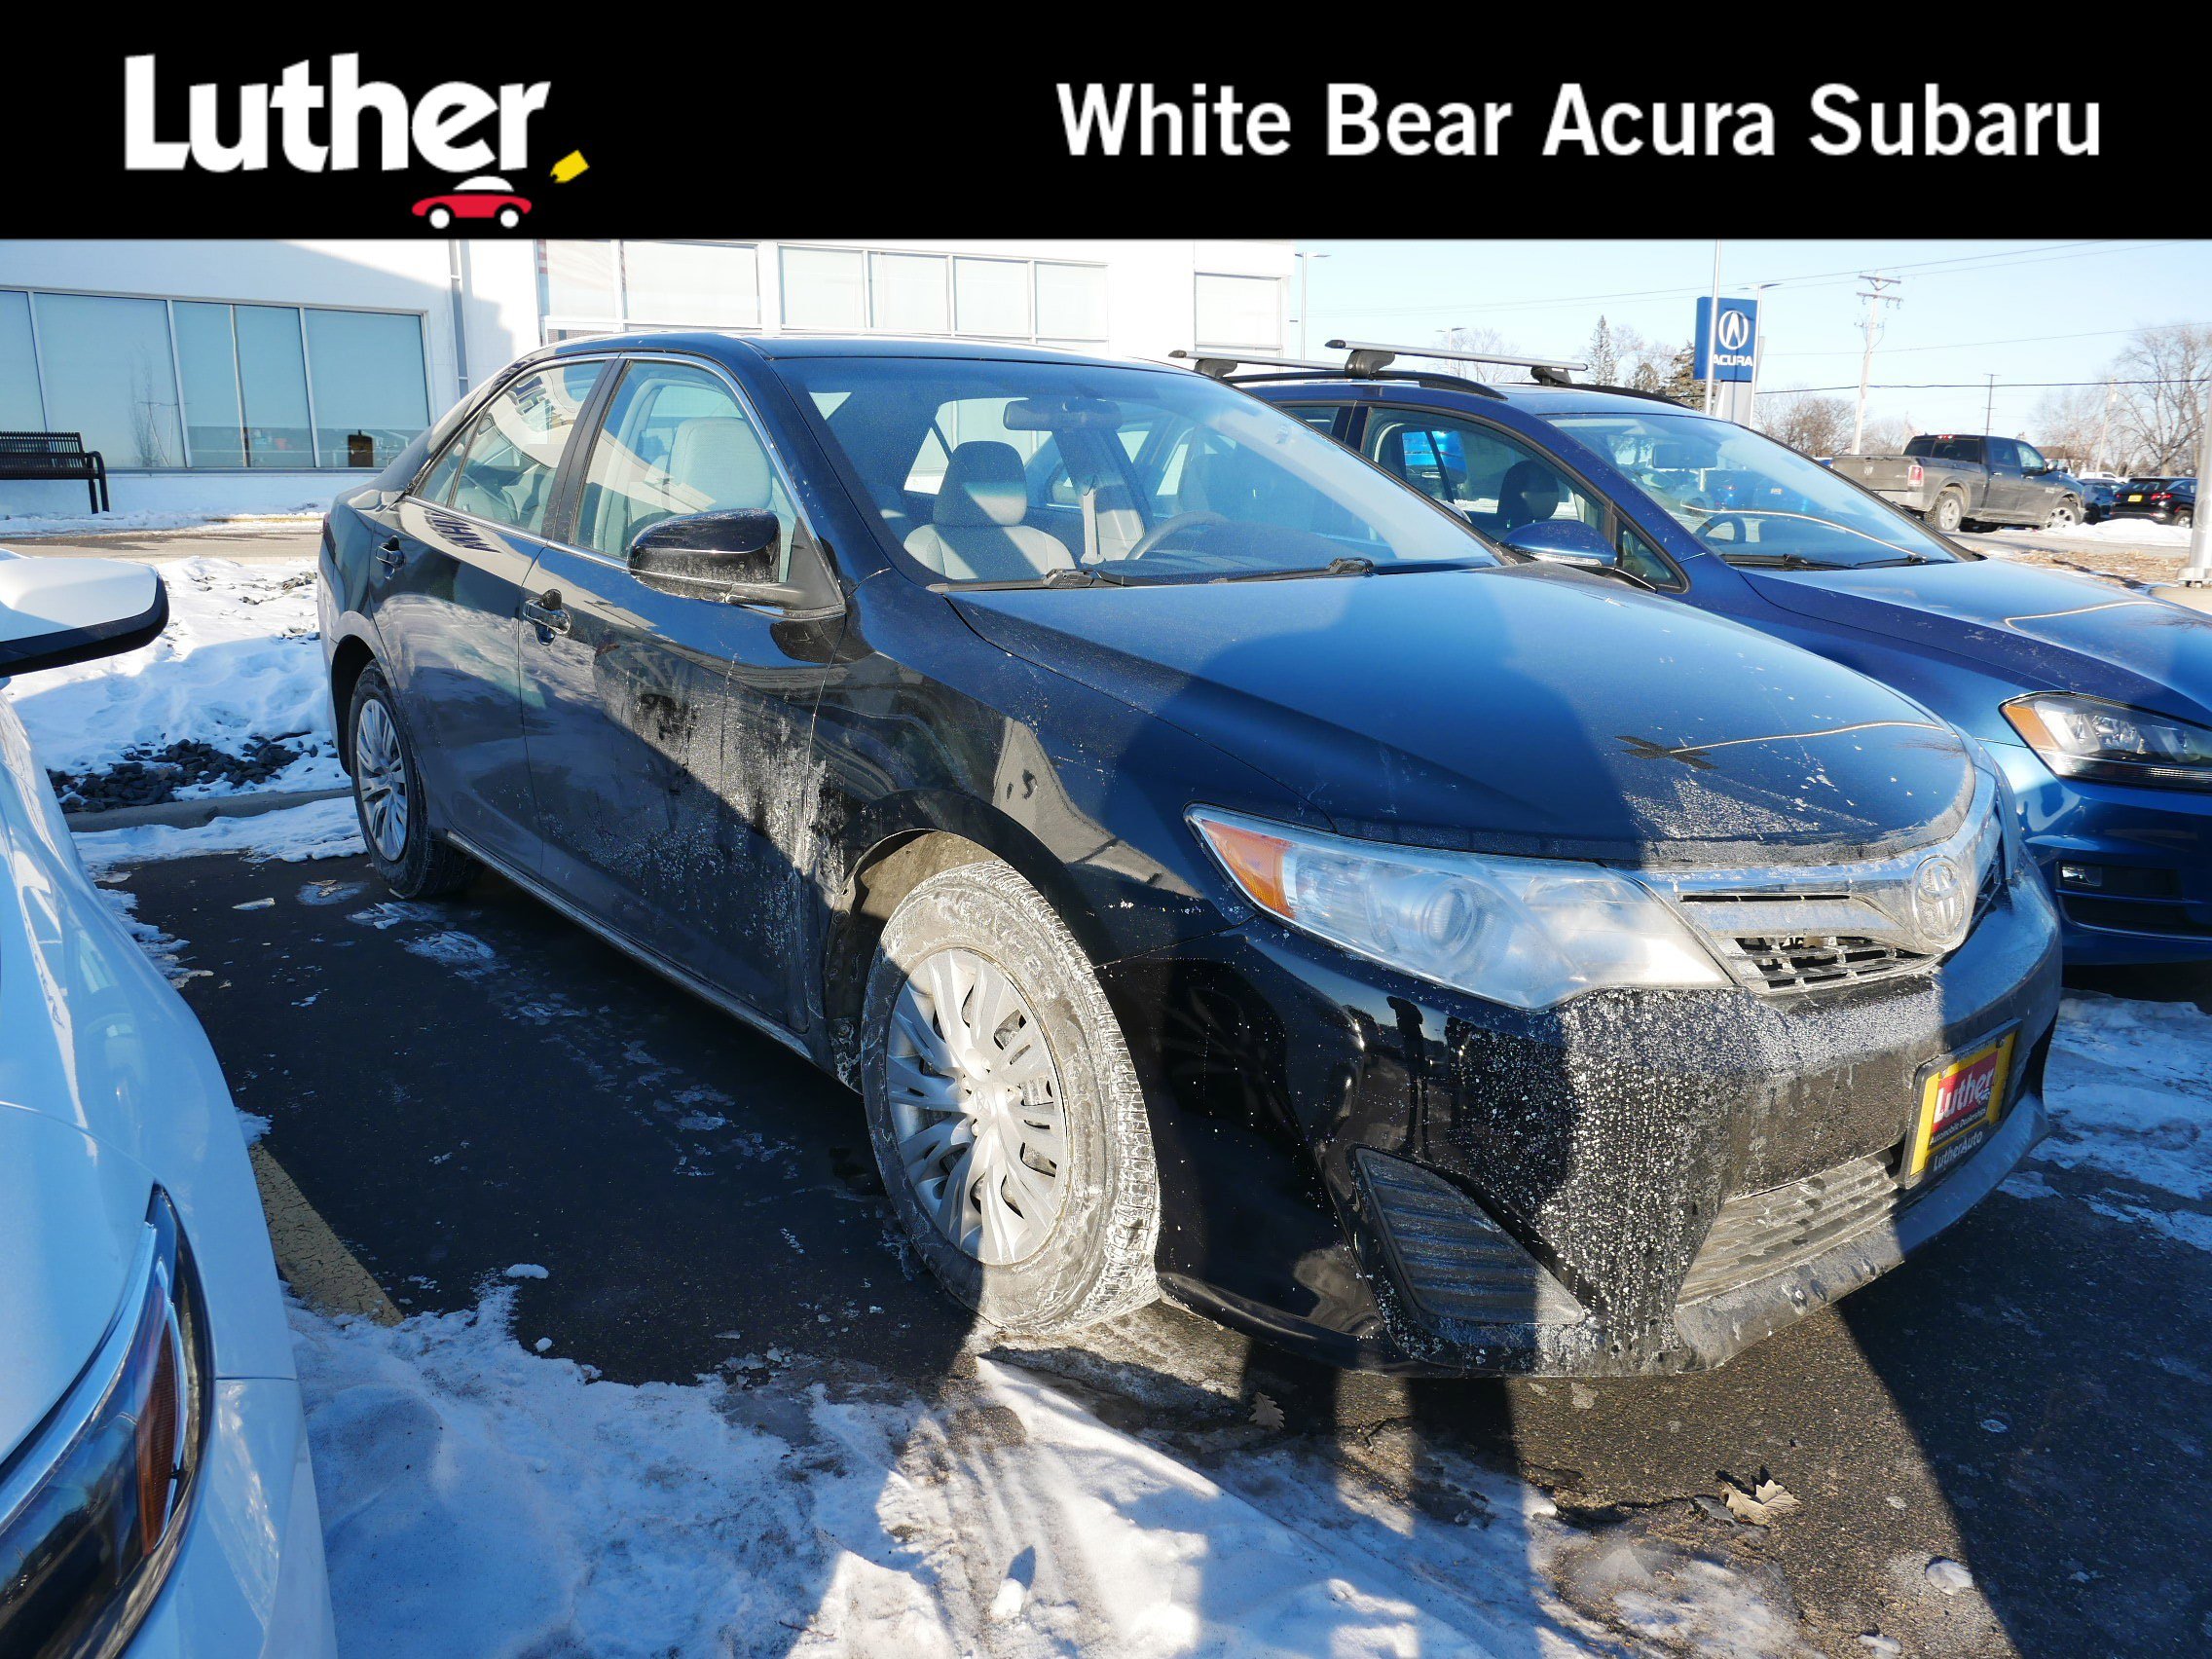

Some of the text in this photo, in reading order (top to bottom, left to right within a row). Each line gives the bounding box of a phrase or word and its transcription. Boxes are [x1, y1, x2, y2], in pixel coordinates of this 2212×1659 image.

[1714, 353, 1753, 367] ACURA
[1933, 1067, 1995, 1124] Luther
[1933, 1130, 1983, 1172] LutherAuto
